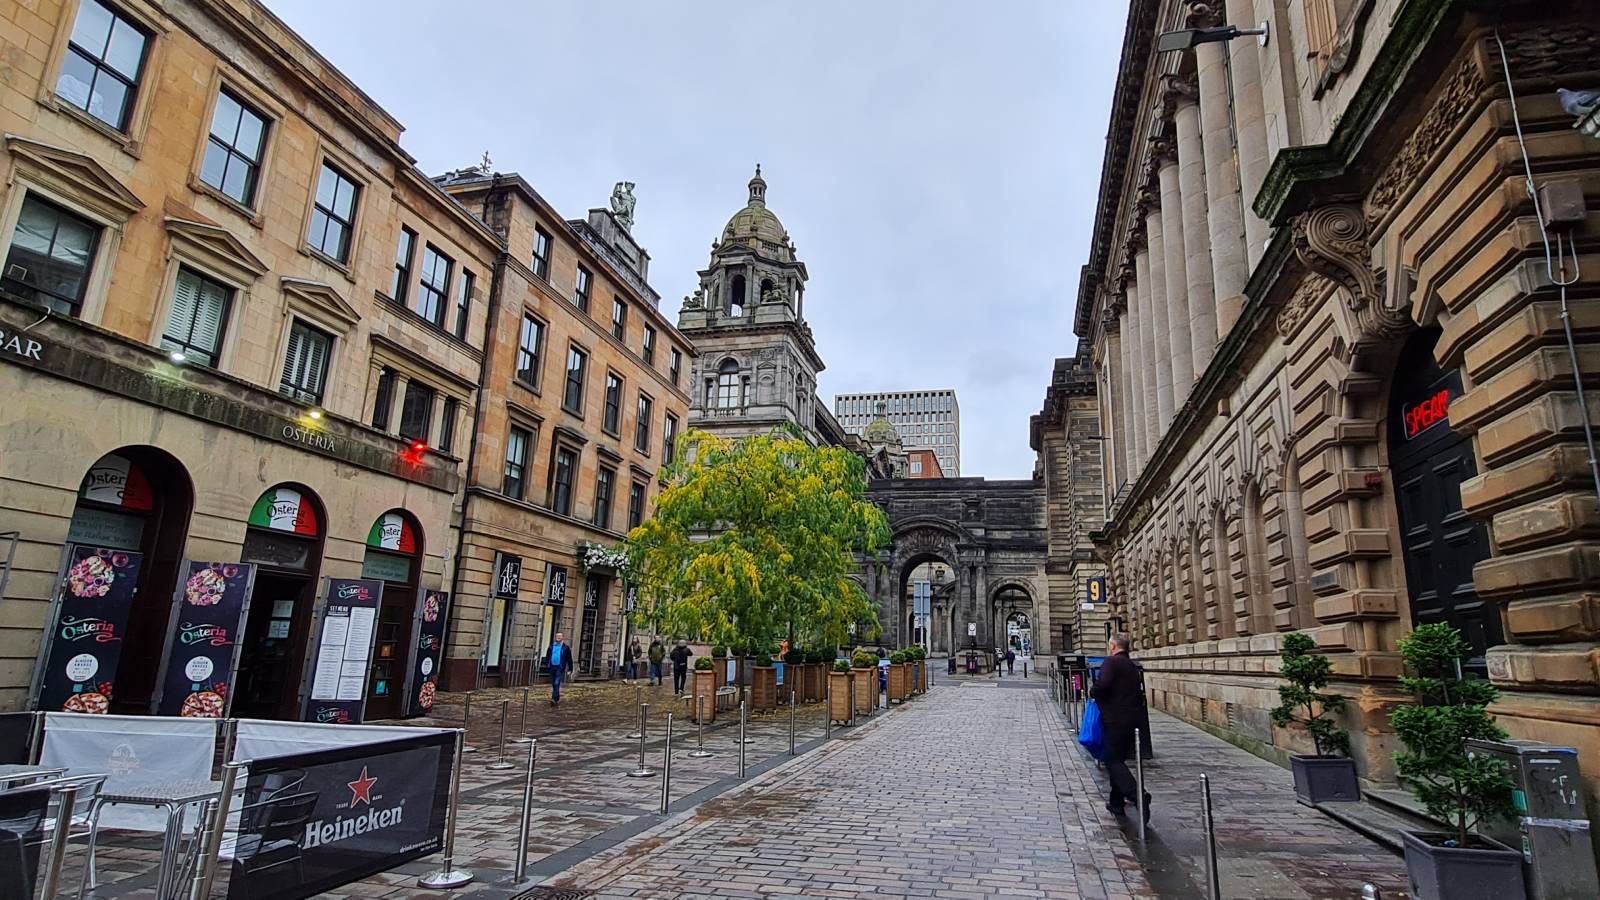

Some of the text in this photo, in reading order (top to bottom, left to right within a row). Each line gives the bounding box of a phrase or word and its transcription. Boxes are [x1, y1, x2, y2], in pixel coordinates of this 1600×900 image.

[282, 425, 336, 452] OSTERIA
[1090, 580, 1100, 601] 9
[61, 618, 116, 641] Osteria
[180, 624, 228, 645] Osteria
[302, 805, 403, 850] Heineken
